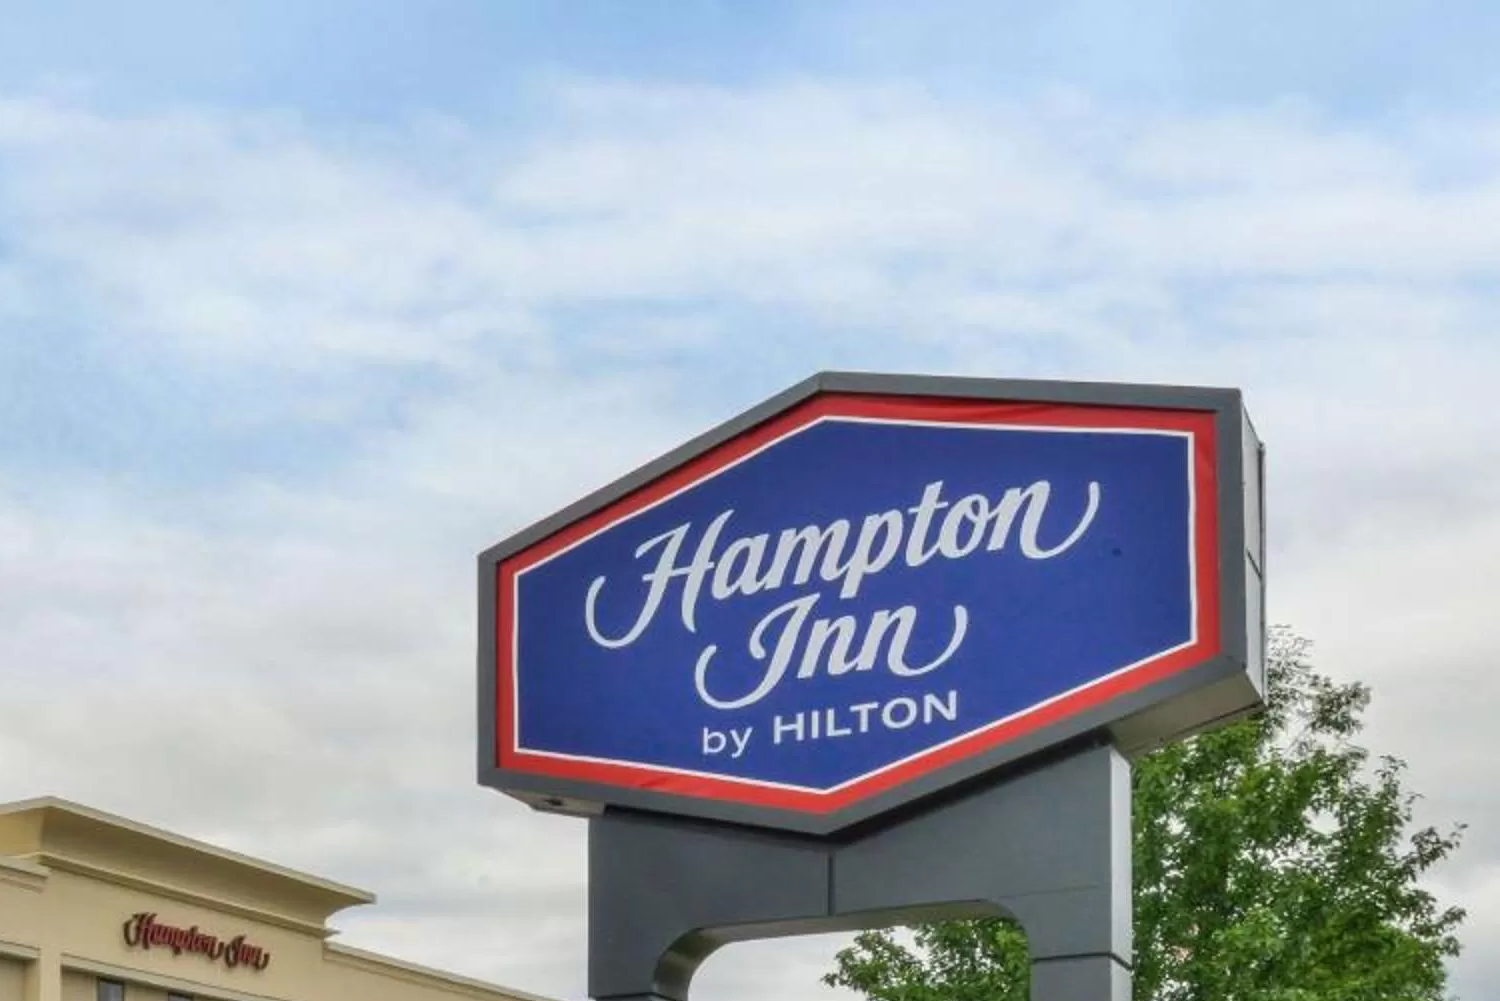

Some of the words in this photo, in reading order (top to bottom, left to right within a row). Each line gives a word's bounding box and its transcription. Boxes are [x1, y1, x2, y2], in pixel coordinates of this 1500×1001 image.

[585, 480, 1101, 650] Hampton
[694, 592, 969, 710] Inn
[702, 727, 753, 759] by
[772, 690, 958, 745] HILTON
[123, 912, 225, 961] Hampton
[225, 934, 269, 970] Inn
